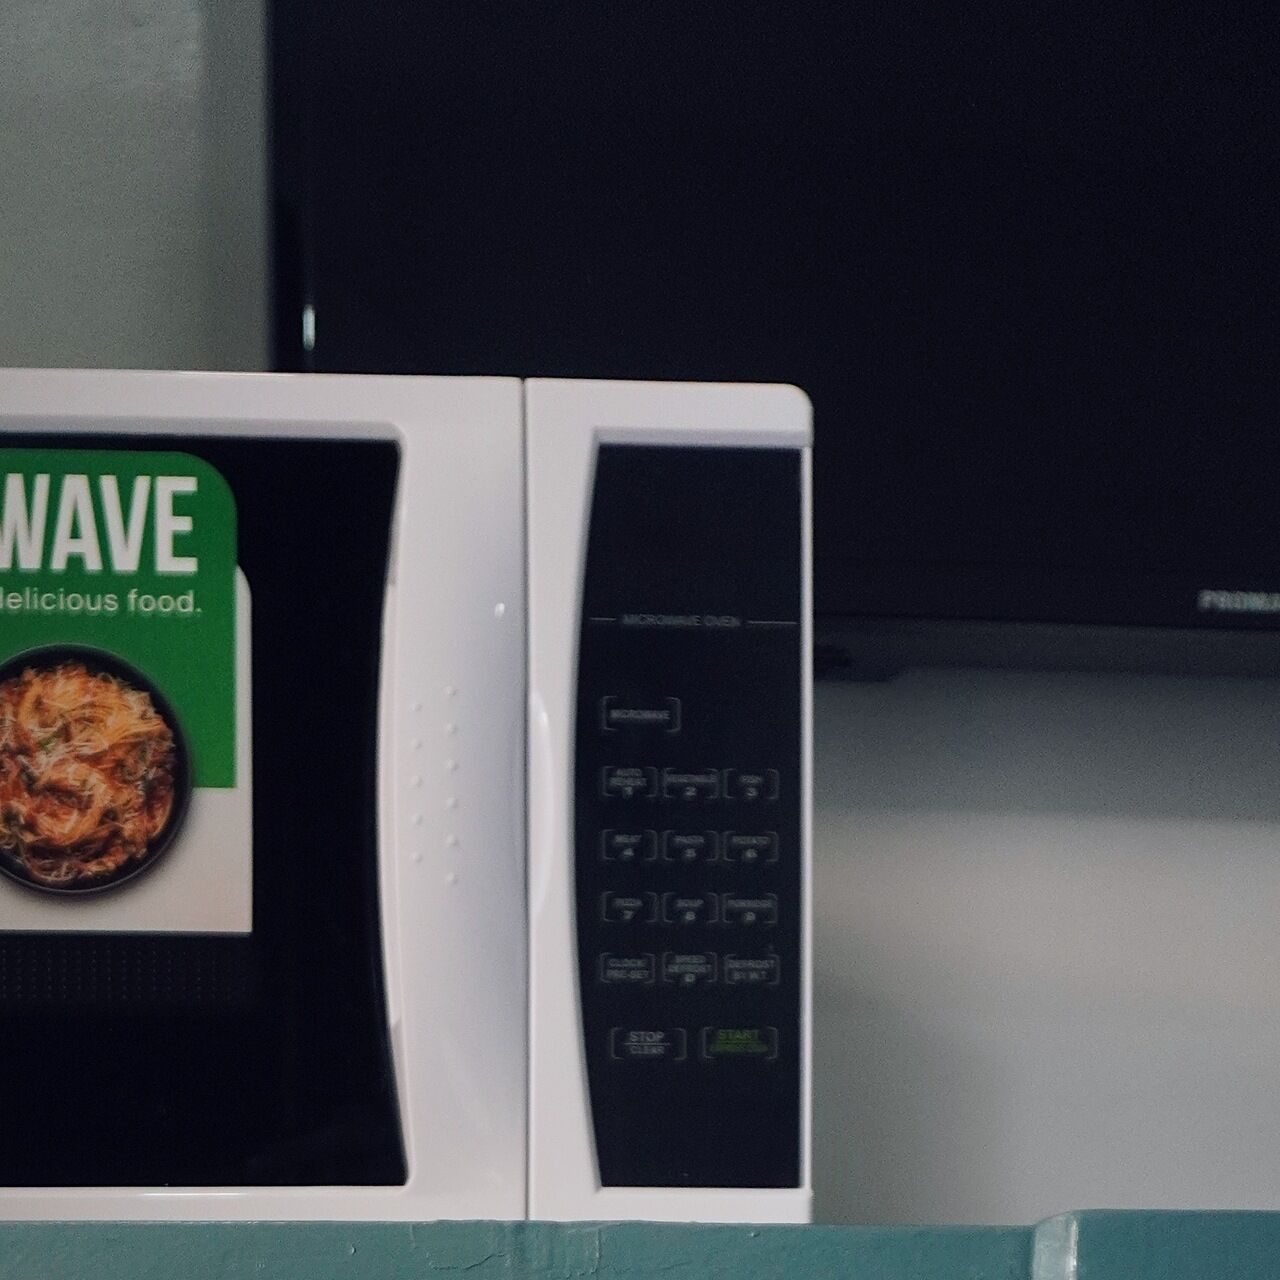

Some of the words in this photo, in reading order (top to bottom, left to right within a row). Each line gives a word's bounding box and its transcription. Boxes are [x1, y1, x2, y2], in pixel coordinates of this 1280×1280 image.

[127, 588, 202, 614] food.
[622, 614, 701, 627] MICROWAVE
[704, 615, 742, 628] OVEN
[685, 786, 697, 796] 2
[746, 787, 758, 797] 3
[628, 1030, 665, 1043] STOP
[719, 1029, 761, 1041] START
[629, 1045, 665, 1056] CLEAR
